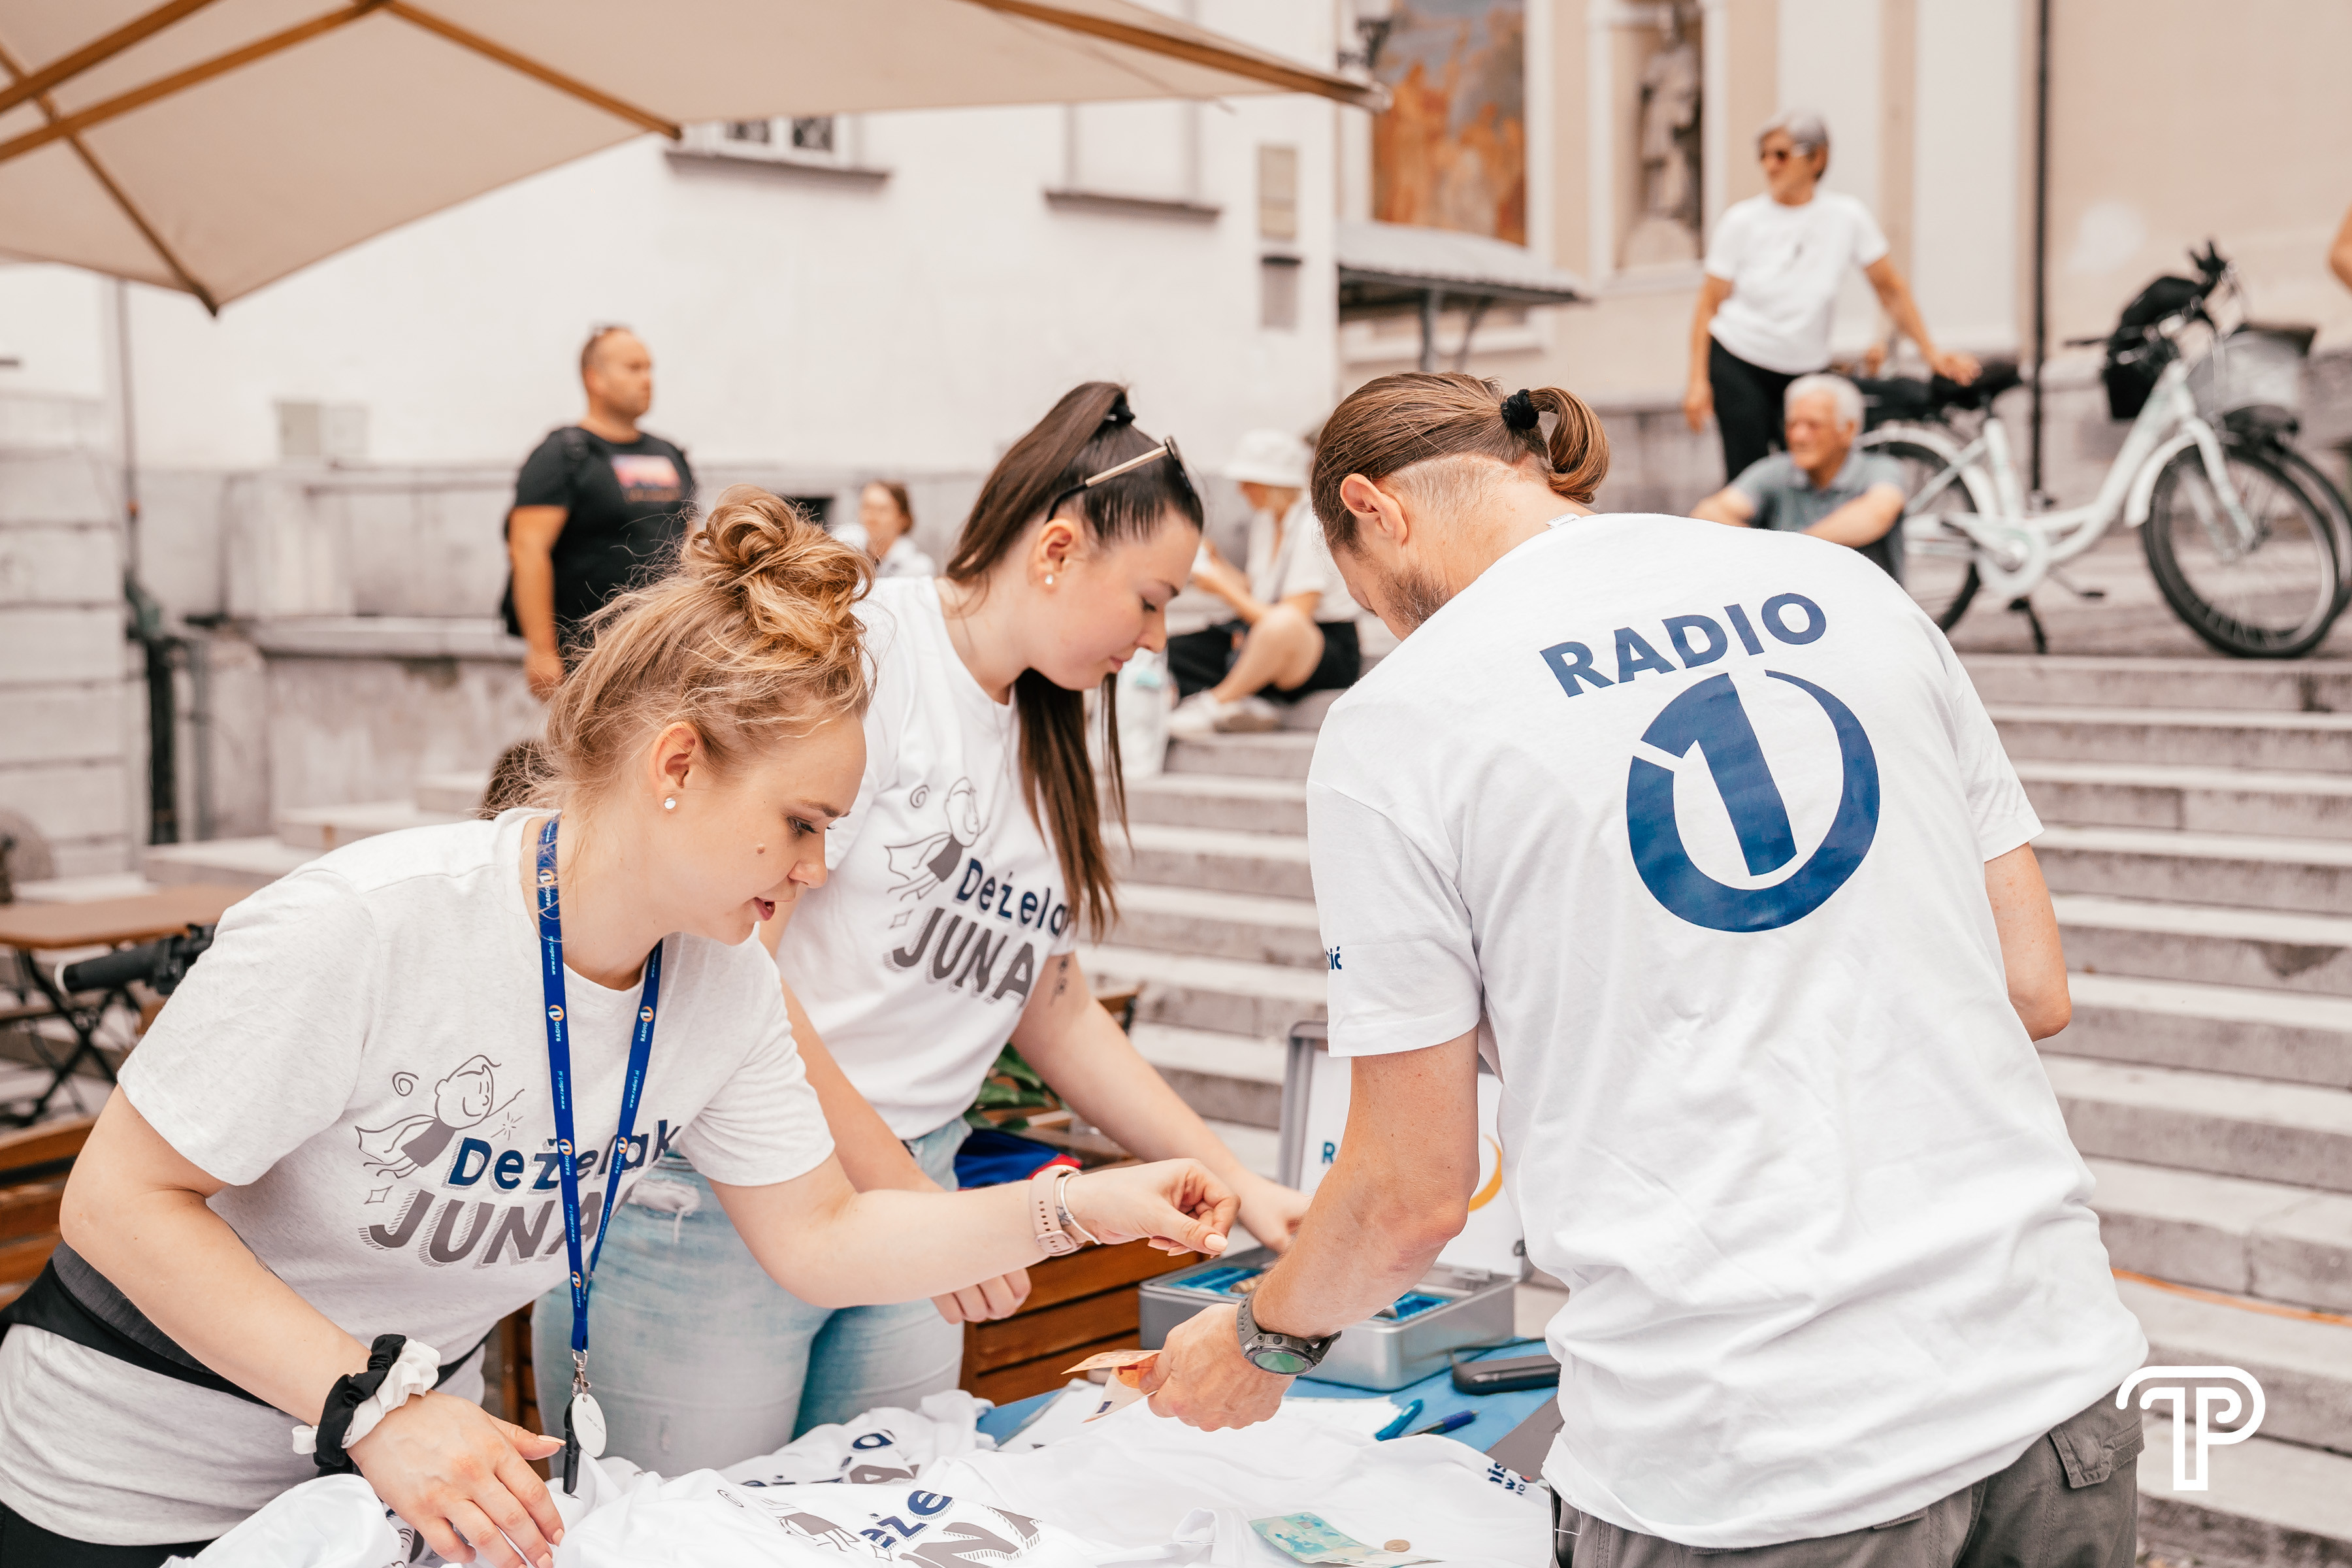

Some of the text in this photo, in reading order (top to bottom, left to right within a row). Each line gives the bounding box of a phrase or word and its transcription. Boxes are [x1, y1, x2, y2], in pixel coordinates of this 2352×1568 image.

[1539, 593, 1827, 697] RADIO
[956, 858, 1069, 936] Dežela
[891, 907, 1034, 1007] JUNA
[1321, 1141, 1335, 1164] R
